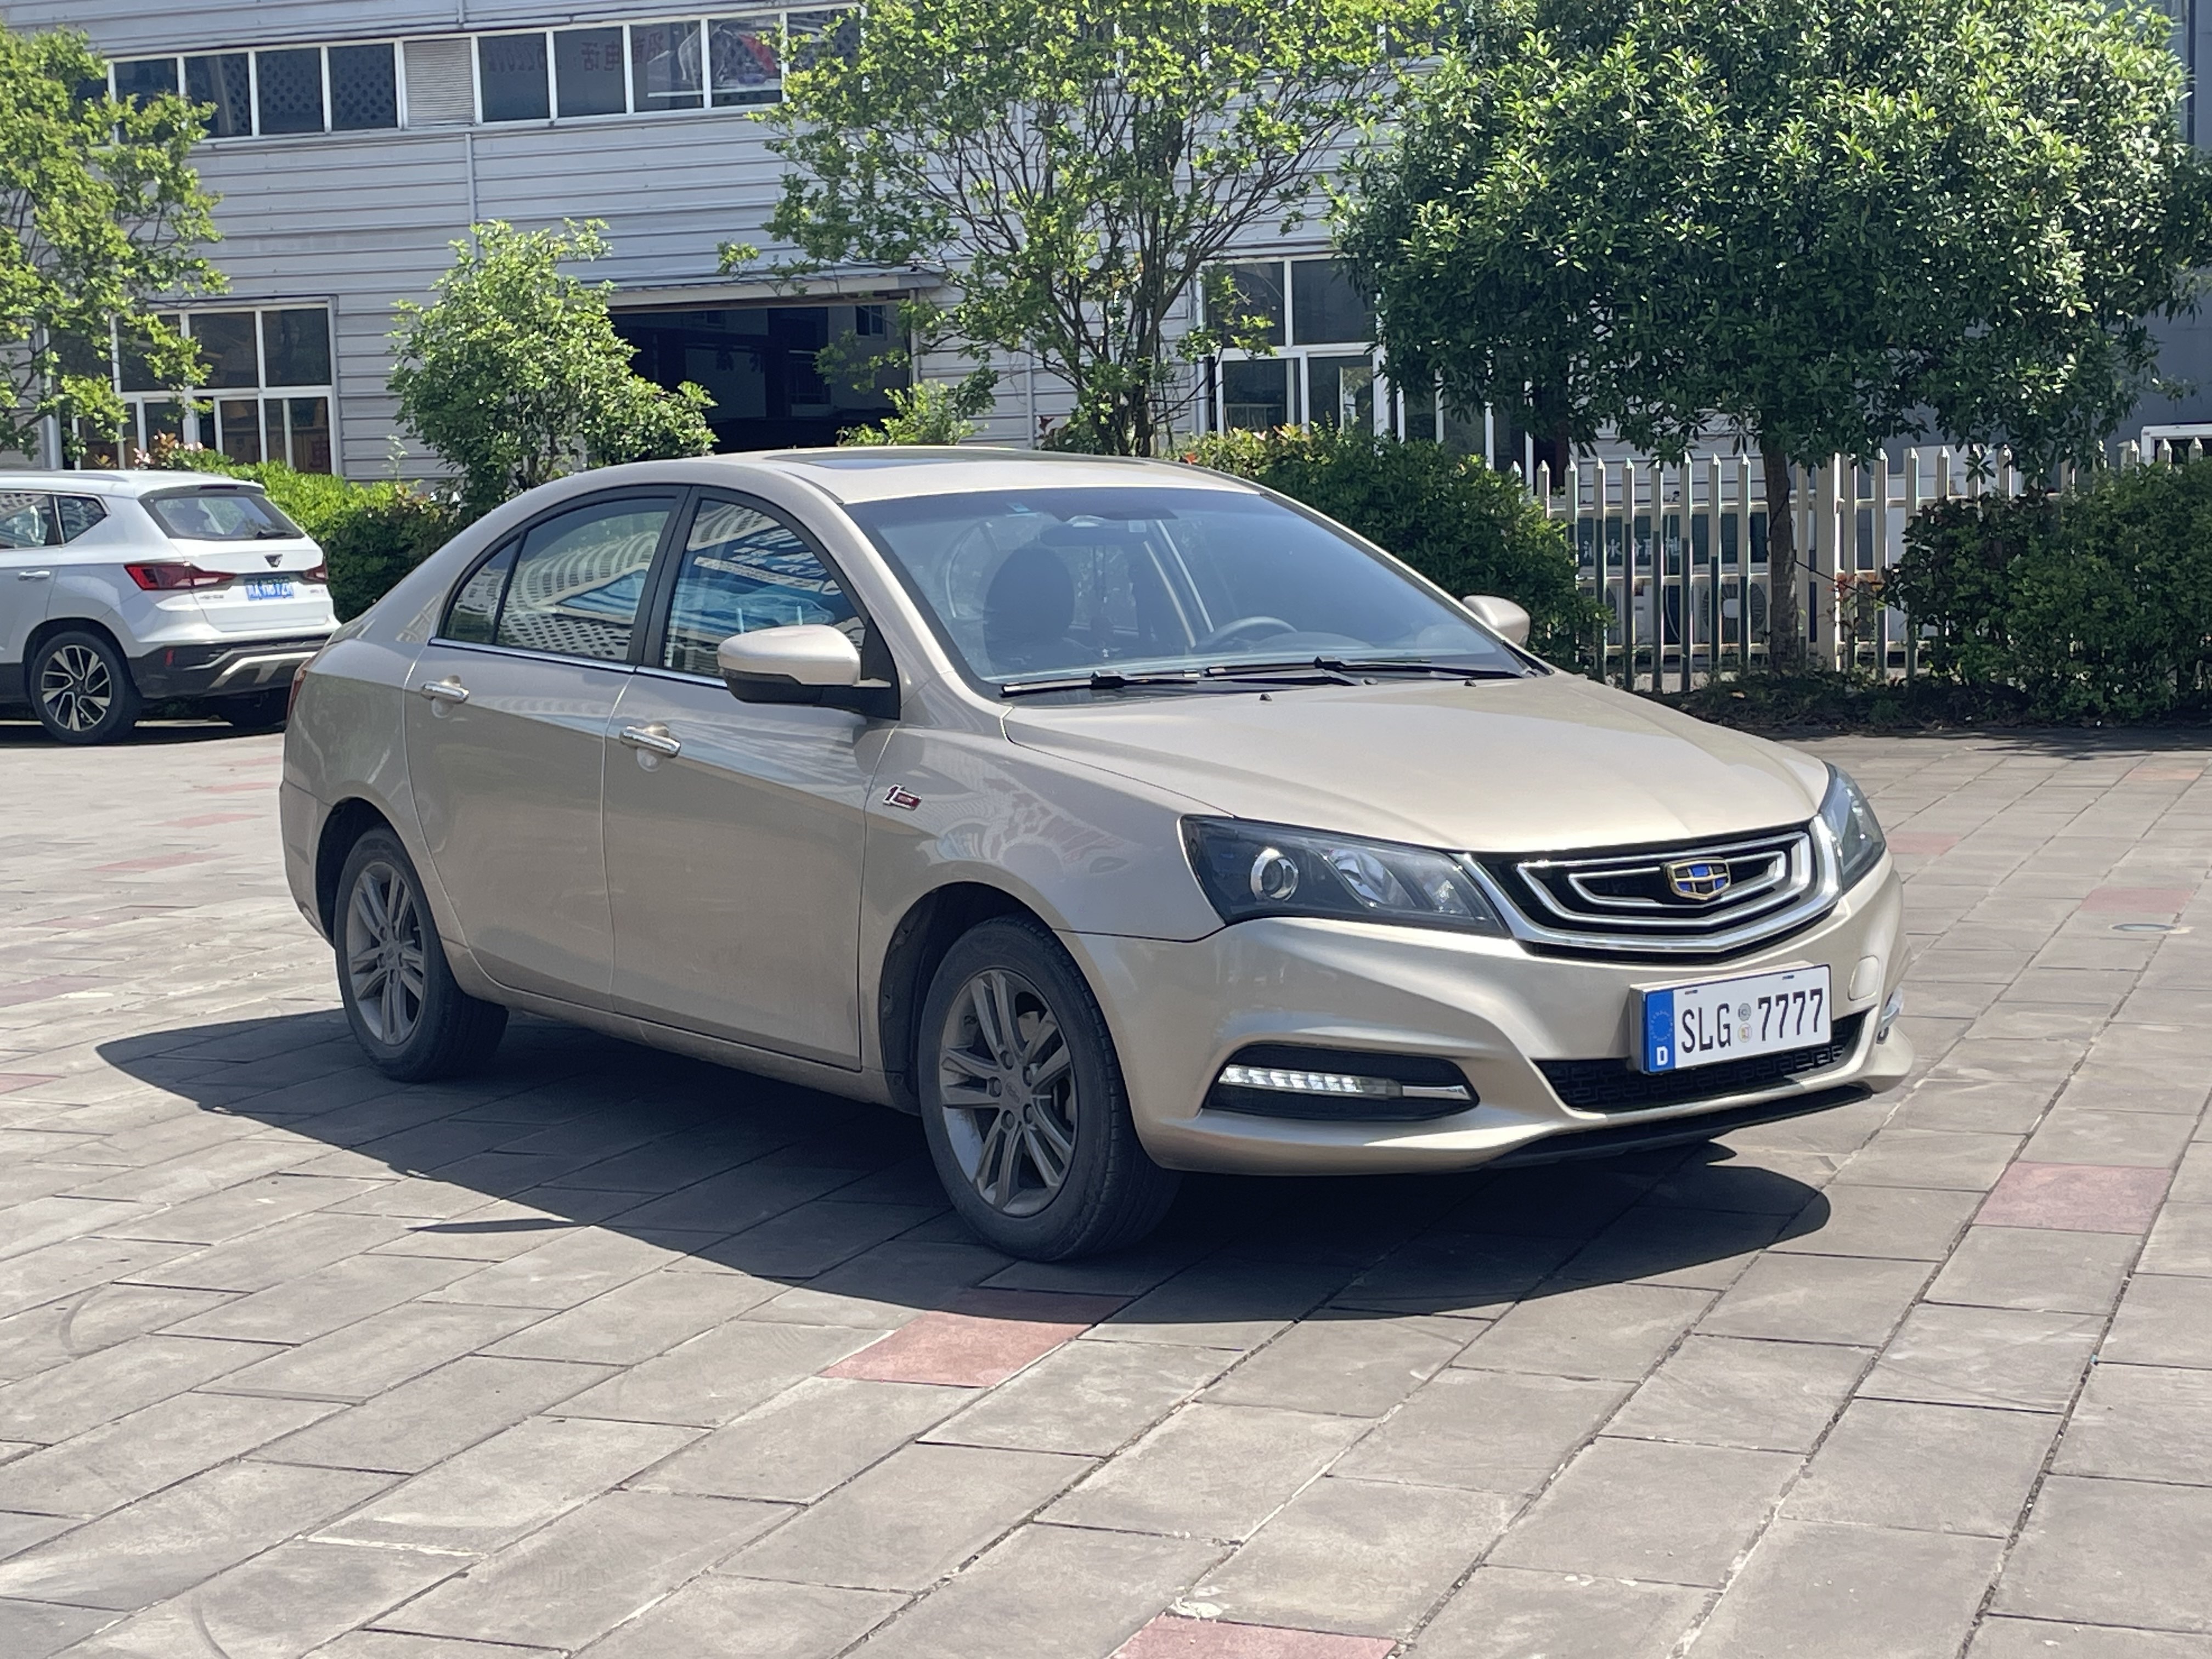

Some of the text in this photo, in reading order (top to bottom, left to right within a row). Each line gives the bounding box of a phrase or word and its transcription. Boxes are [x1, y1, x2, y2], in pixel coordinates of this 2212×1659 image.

[1681, 988, 1824, 1053] SLG 7777
[1656, 1046, 1668, 1066] D
